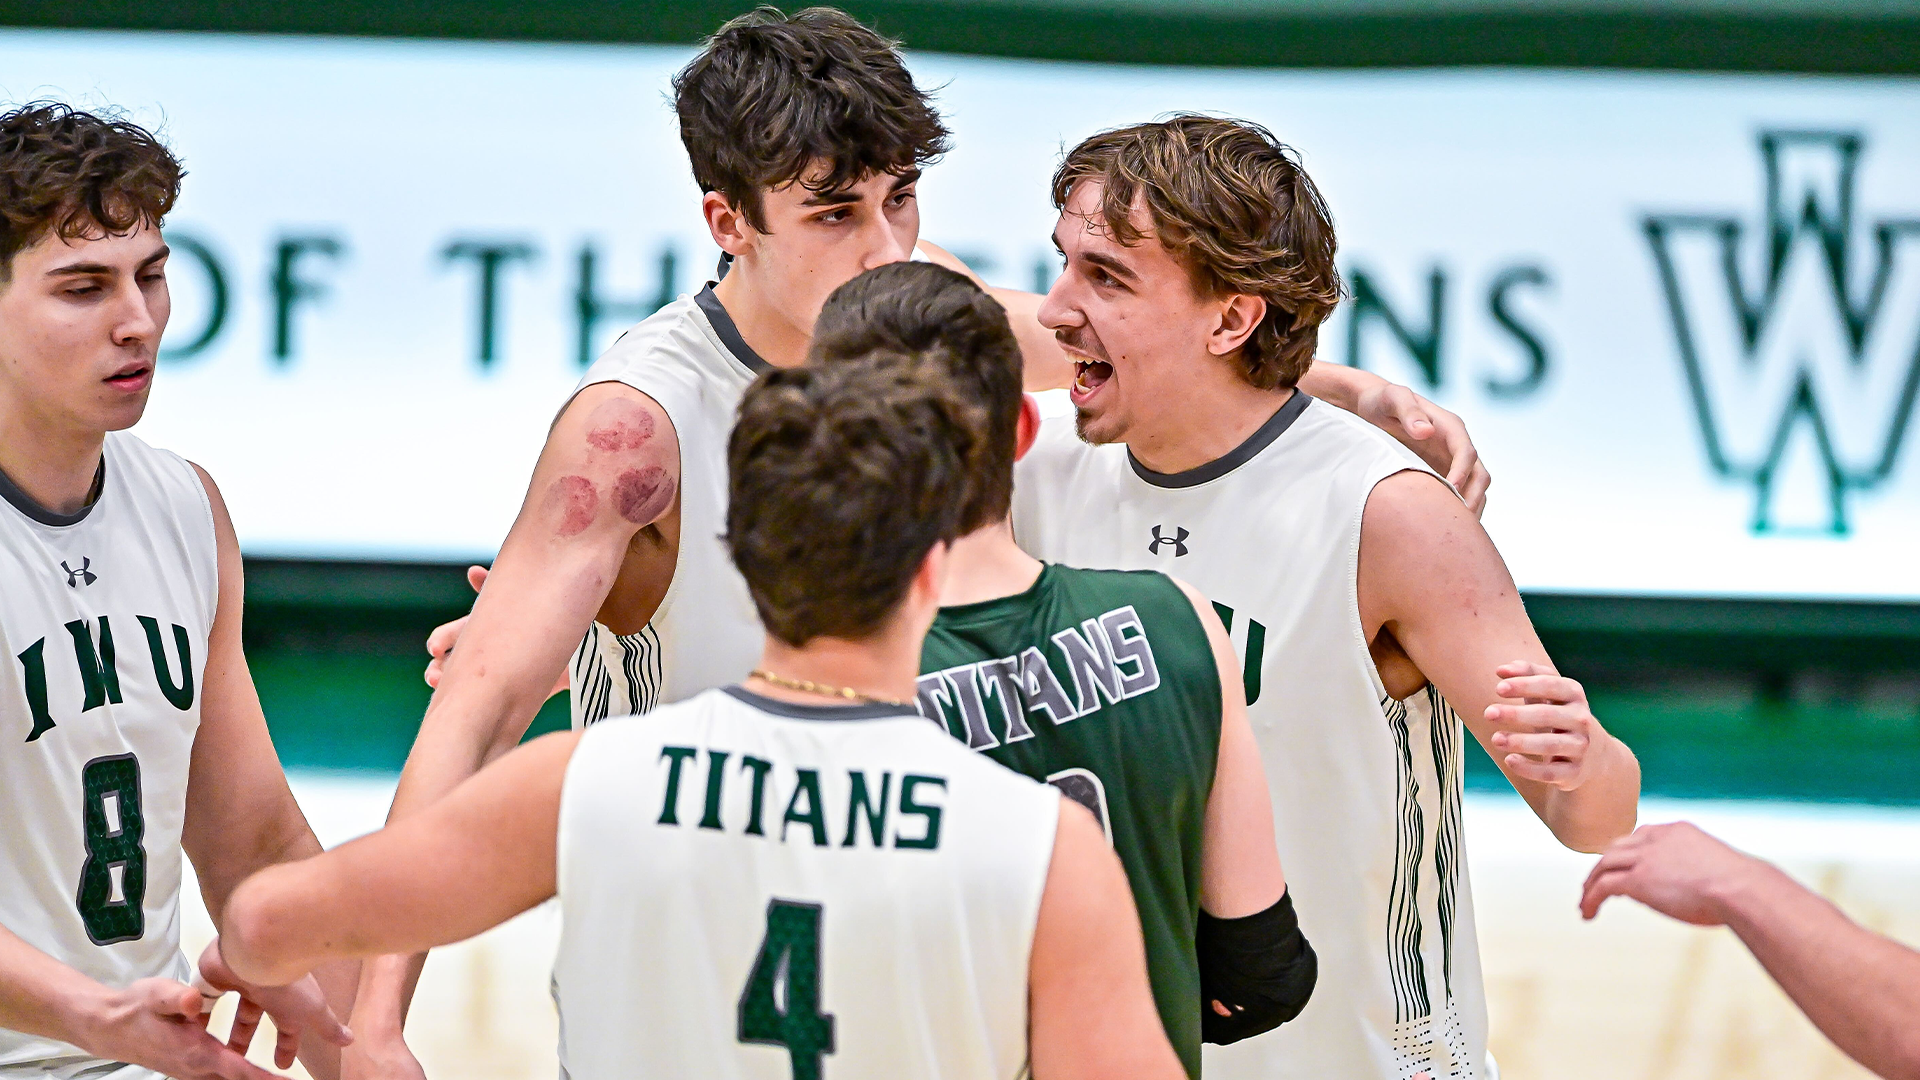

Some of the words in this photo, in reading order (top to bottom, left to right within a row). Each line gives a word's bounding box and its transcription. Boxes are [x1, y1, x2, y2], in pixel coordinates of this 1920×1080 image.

[440, 241, 676, 366] TH
[17, 614, 195, 743] IWU
[913, 604, 1161, 751] TITANS
[76, 752, 147, 947] 8
[656, 746, 950, 851] TITANS
[737, 898, 836, 1080] 4
